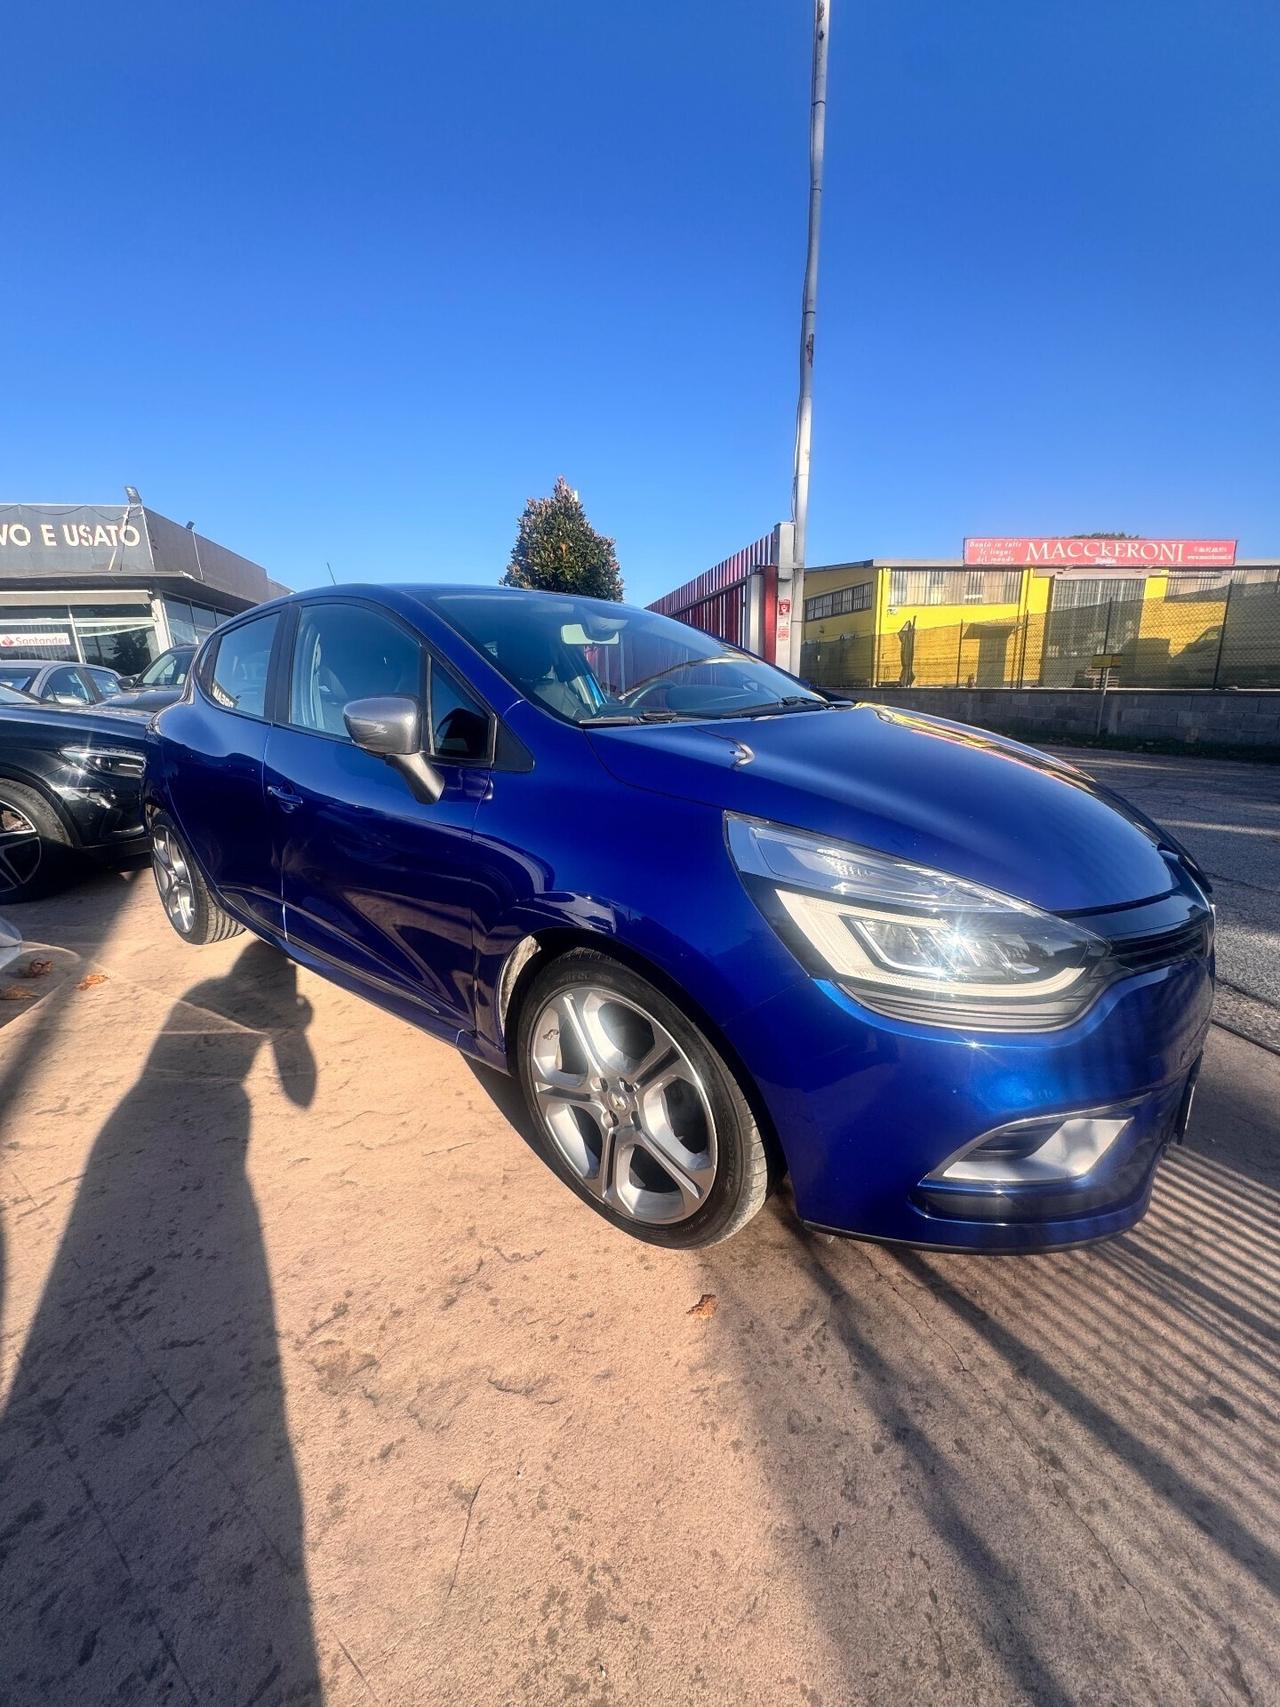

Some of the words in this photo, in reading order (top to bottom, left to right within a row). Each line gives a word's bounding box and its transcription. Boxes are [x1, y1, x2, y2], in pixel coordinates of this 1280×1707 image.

[40, 524, 57, 546] E
[62, 523, 141, 547] USATO
[16, 636, 67, 645] Santander
